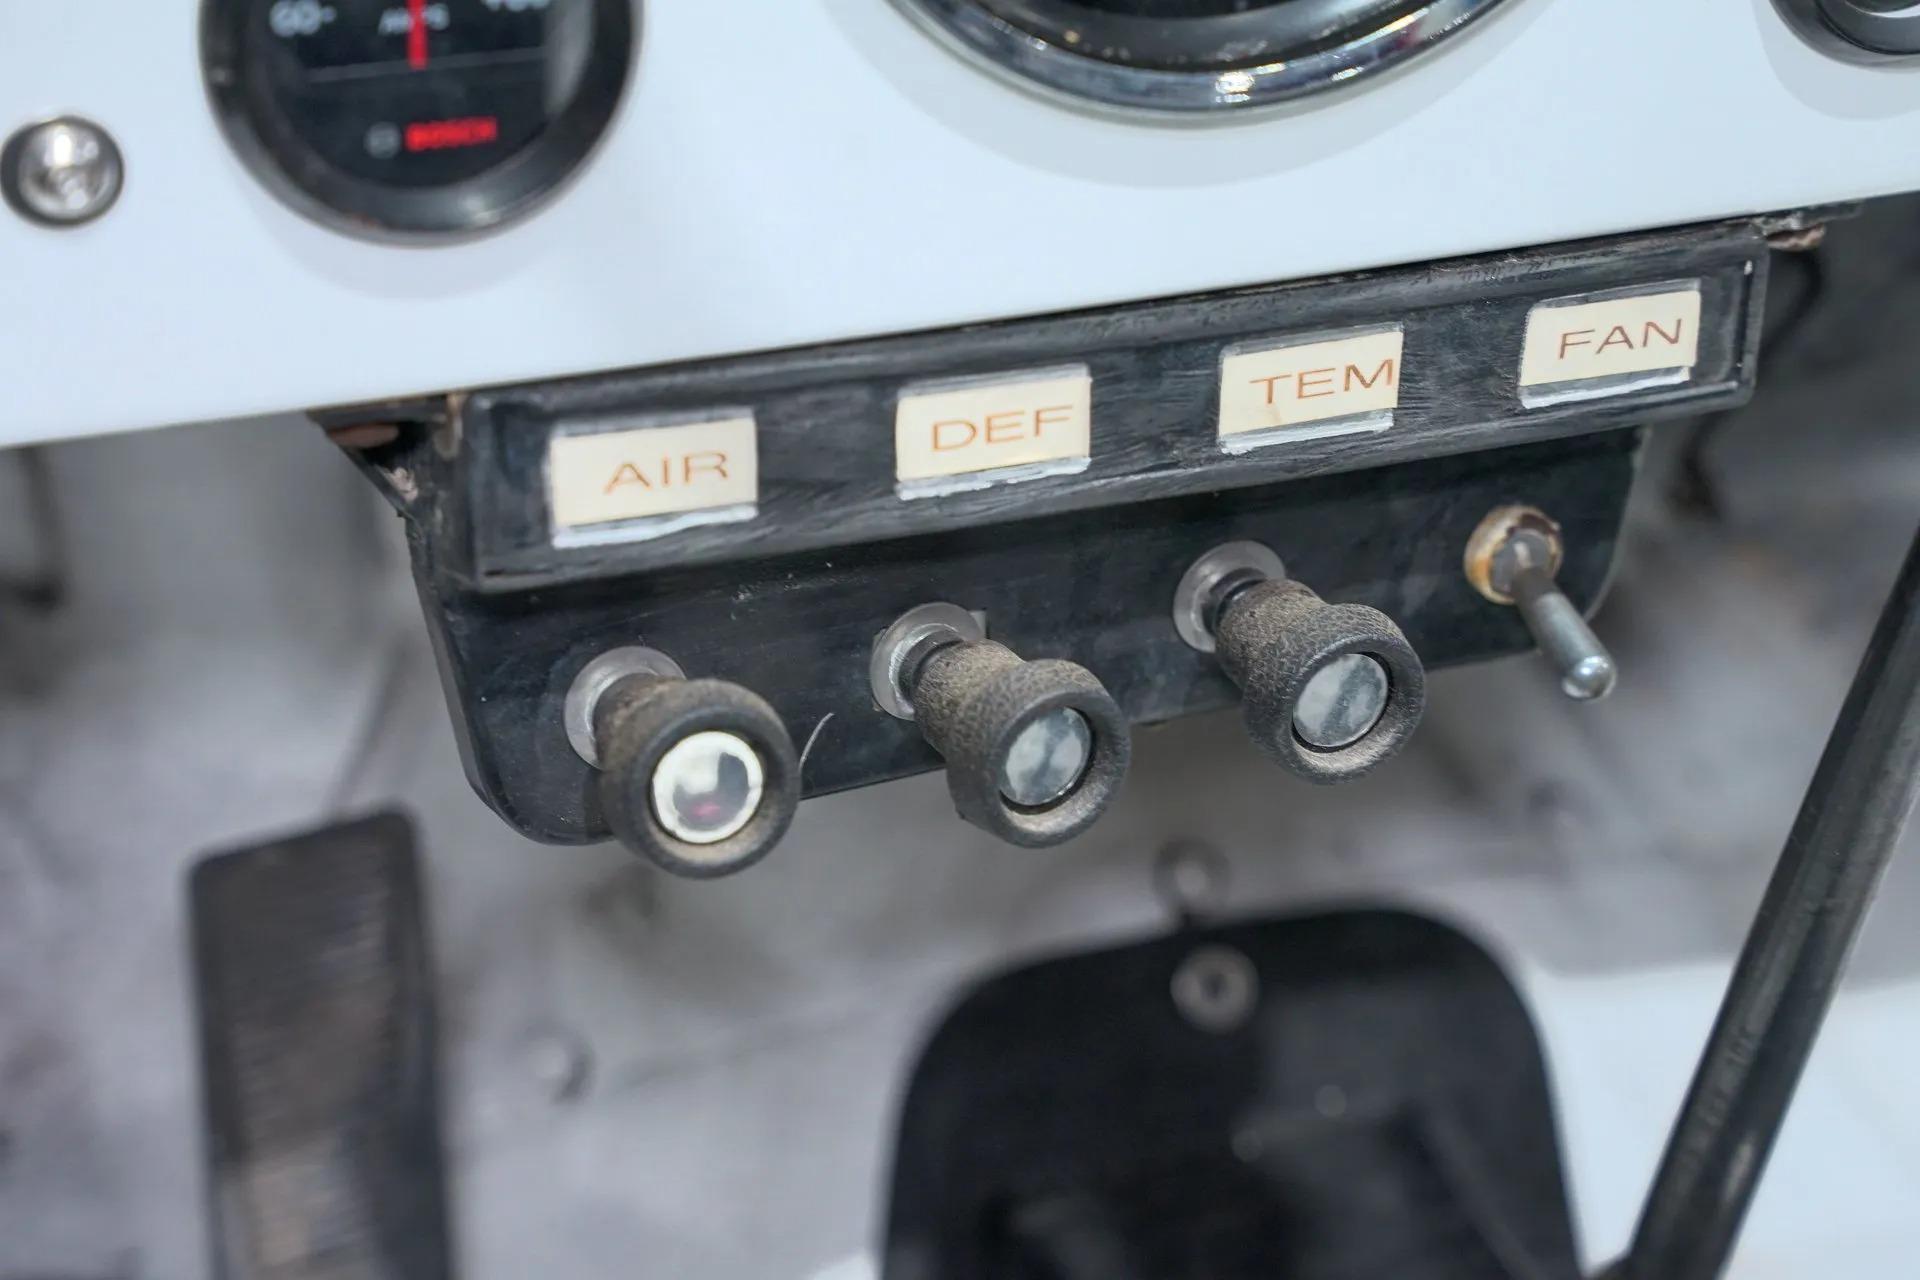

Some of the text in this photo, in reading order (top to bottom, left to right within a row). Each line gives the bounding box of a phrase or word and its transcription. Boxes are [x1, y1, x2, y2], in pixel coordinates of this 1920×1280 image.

[378, 3, 450, 35] AMS
[1558, 317, 1683, 360] FAN
[1249, 358, 1394, 405] TEM
[930, 404, 1074, 452] DEF
[603, 450, 729, 494] AIR
